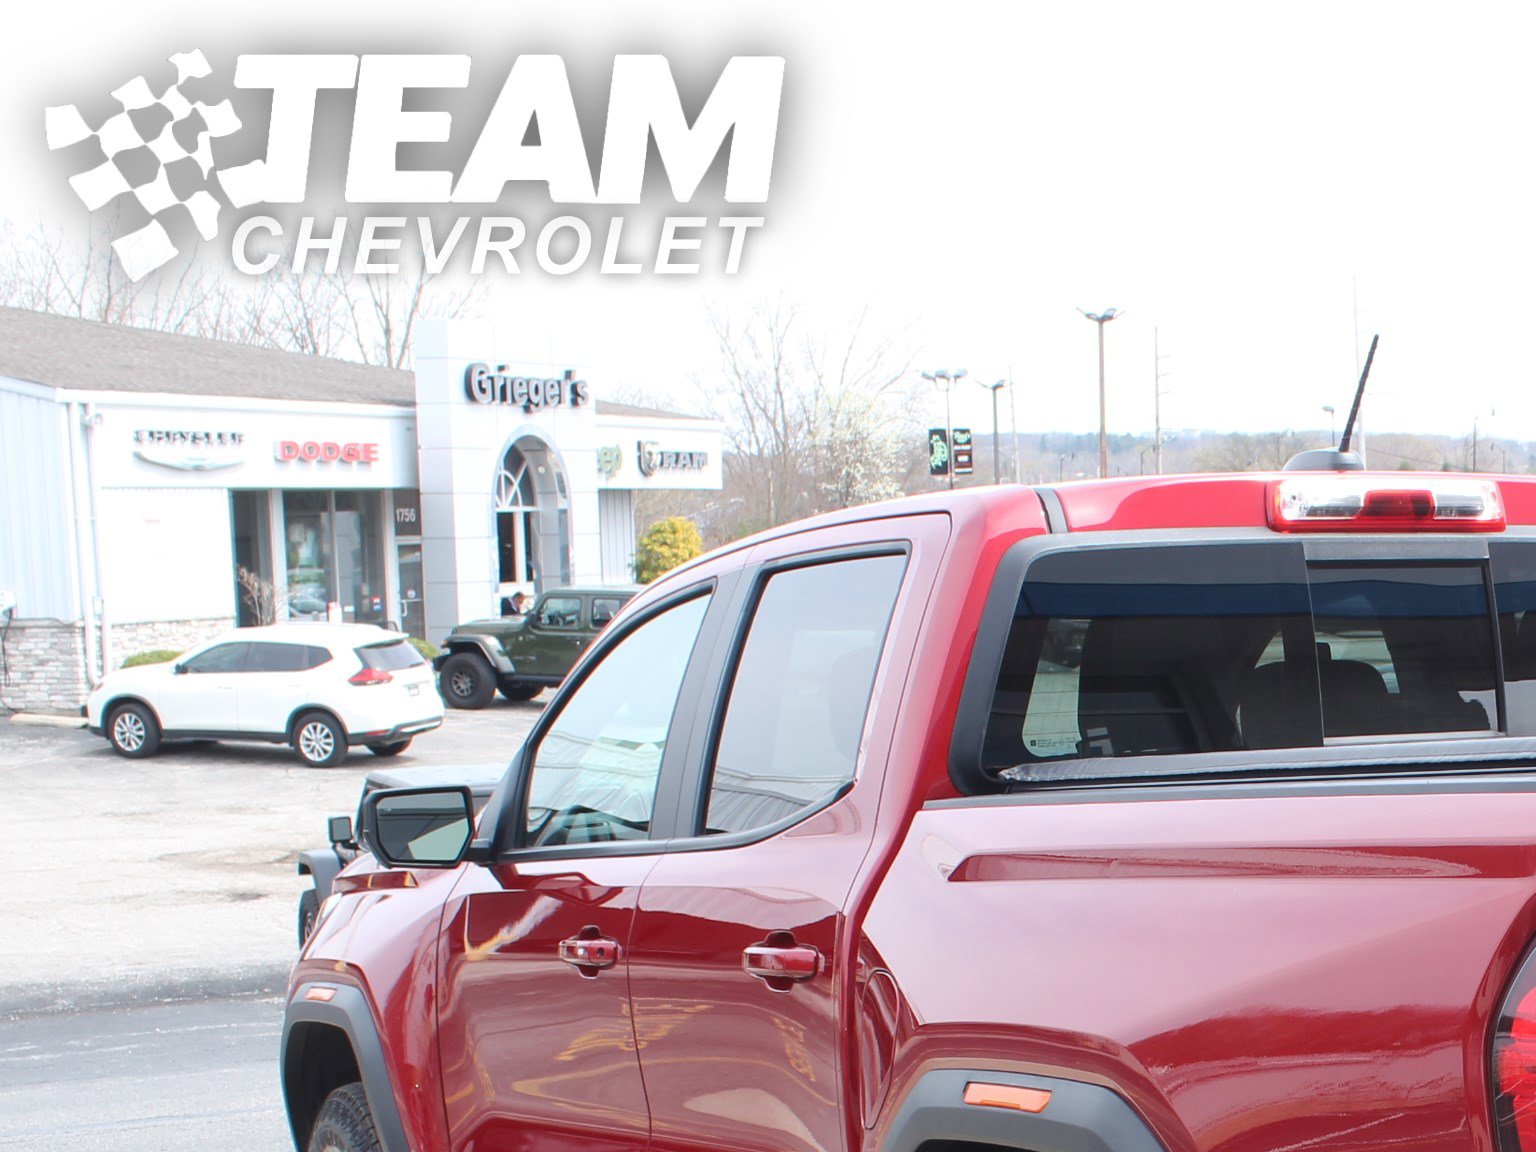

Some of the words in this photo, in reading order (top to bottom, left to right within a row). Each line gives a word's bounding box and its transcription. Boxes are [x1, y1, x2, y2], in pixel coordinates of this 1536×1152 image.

[465, 362, 589, 413] Grieger's
[275, 440, 380, 465] DODGE
[660, 449, 709, 470] RAM
[395, 507, 416, 524] 1756
